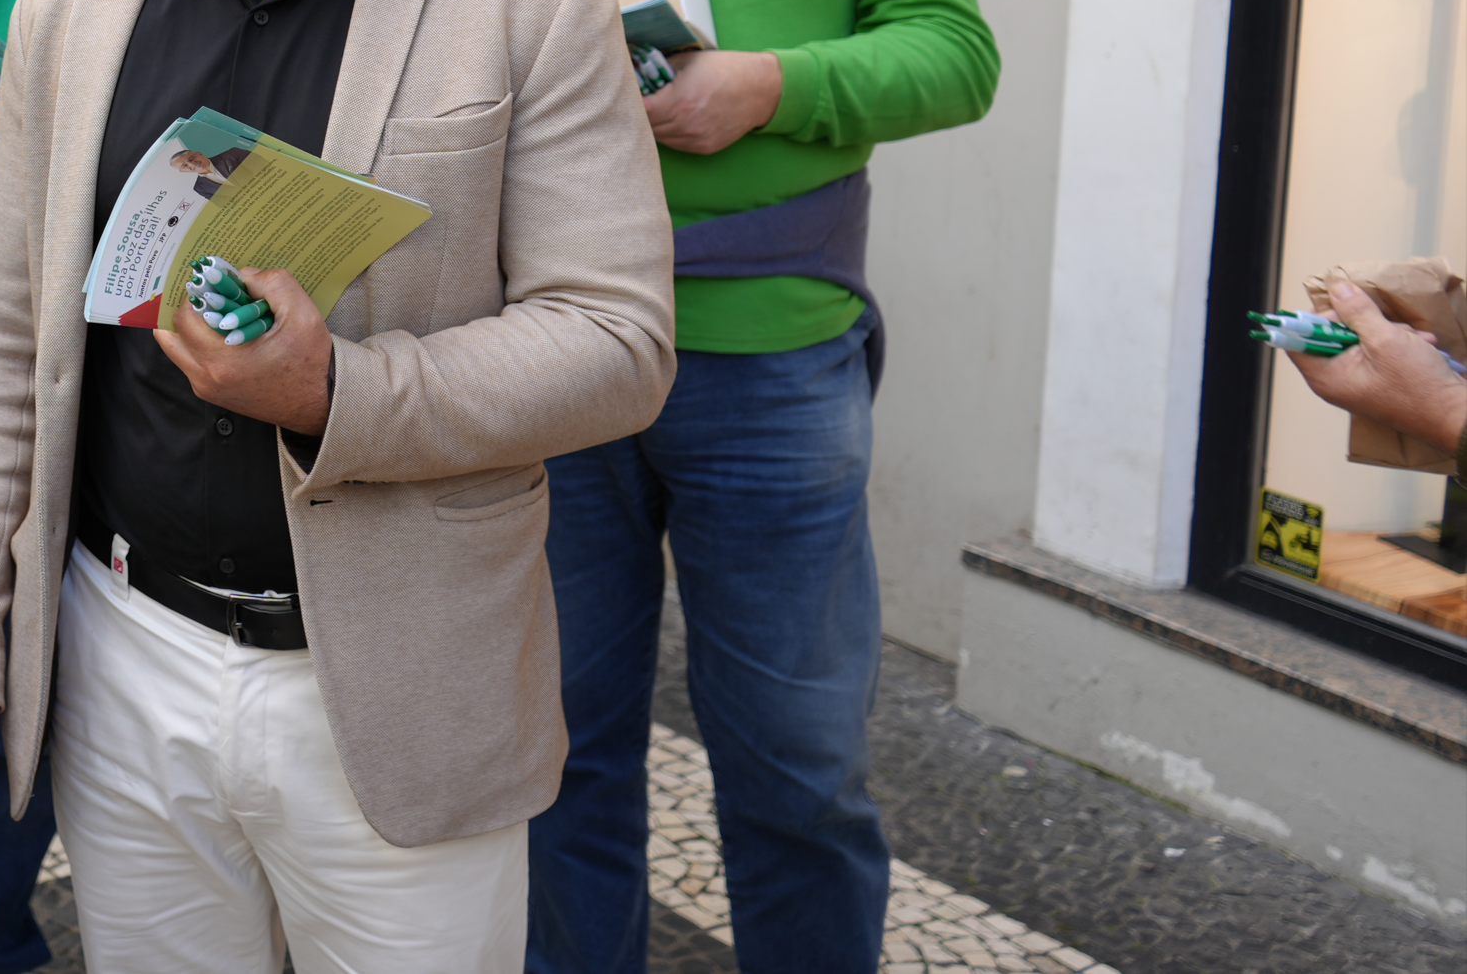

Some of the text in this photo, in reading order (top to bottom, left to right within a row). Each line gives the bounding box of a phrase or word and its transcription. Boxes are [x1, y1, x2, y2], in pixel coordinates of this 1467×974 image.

[105, 210, 144, 294] Filipe Sousa,
[115, 189, 167, 296] uma voz das ilhas
[124, 215, 162, 298] por Portugal!
[138, 277, 147, 298] Juntos
